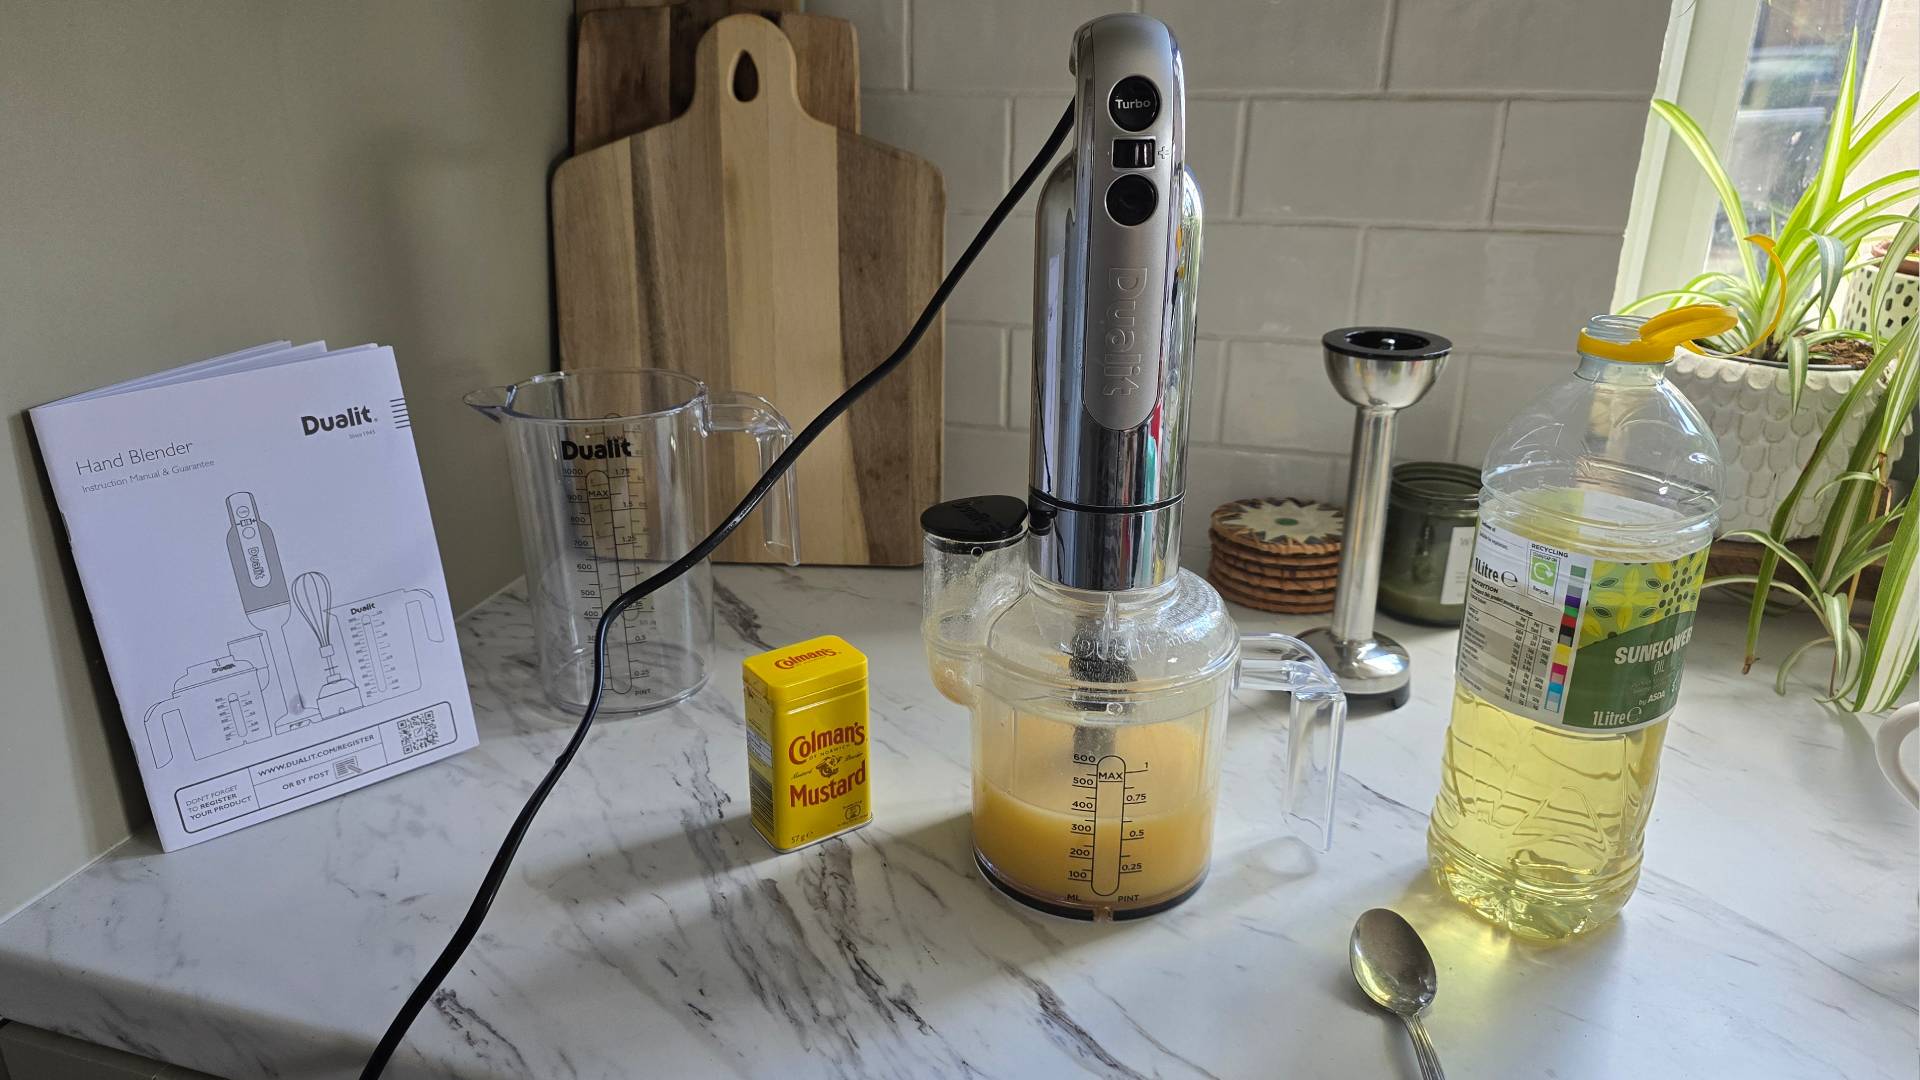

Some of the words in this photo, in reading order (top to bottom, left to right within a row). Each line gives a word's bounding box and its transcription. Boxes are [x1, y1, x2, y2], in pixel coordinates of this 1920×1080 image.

[1115, 99, 1151, 109] Turbo
[1103, 267, 1148, 397] Dualit
[301, 405, 373, 436] Dualit
[76, 453, 124, 476] Hand
[128, 442, 193, 465] Blender
[561, 437, 632, 460] Dualit
[82, 477, 128, 493] Instruction
[130, 470, 160, 484] Manual
[162, 468, 170, 477] &
[171, 459, 215, 474] Guarantee
[1531, 543, 1568, 558] RECYCLING
[1472, 578, 1499, 593] NUTRITION
[350, 603, 375, 615] Dualit
[1614, 626, 1693, 664] SUNFLOWER
[775, 648, 836, 669] Colman's
[1648, 690, 1666, 703] ASDA
[788, 722, 866, 765] Colman's
[258, 734, 375, 777] WWW.DUALIT.COM/REGISTER
[1073, 753, 1096, 763] 600
[282, 782, 294, 790] OR
[296, 778, 307, 786] BY
[309, 770, 329, 782] POST
[789, 760, 866, 807] Mustard
[1099, 772, 1123, 780] MAX
[185, 793, 211, 806] DON'T
[211, 784, 238, 798] FORGET
[1073, 776, 1094, 786] 500
[1126, 793, 1146, 802] 0.75
[188, 805, 199, 813] TO
[200, 793, 237, 809] REGISTER
[190, 809, 213, 821] YOUR
[214, 795, 251, 814] PRODUCT
[1072, 801, 1093, 809] 400
[1071, 824, 1092, 832] 300
[1129, 829, 1144, 837] 0.5
[1070, 848, 1090, 856] 200
[1121, 863, 1142, 871] 0.25
[1068, 870, 1087, 879] 100
[1118, 894, 1140, 902] PINT
